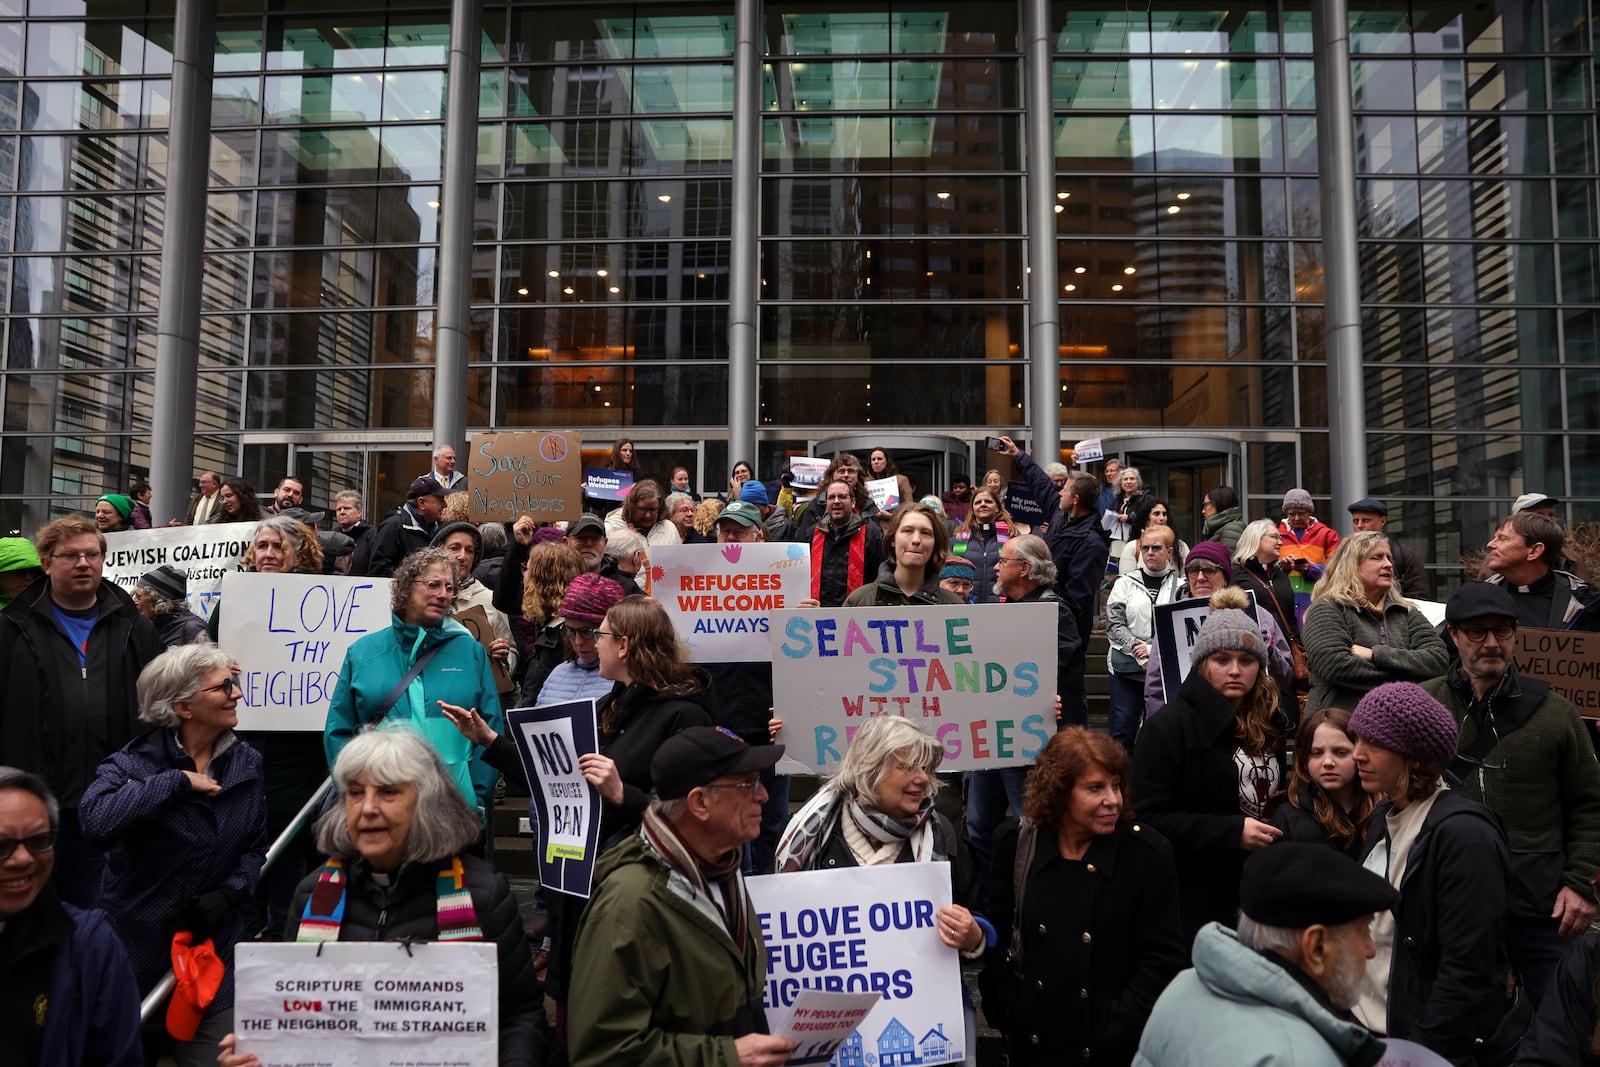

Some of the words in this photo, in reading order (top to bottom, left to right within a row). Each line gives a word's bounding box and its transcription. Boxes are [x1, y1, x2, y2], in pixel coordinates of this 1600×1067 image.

[473, 441, 539, 477] Save
[513, 471, 562, 489] Our
[588, 475, 620, 484] Refugees
[588, 481, 620, 490] Welcome
[473, 488, 566, 520] Neighbors
[105, 547, 167, 567] JEWISH
[173, 541, 251, 562] COALITION
[680, 574, 782, 591] REFUGEES
[268, 584, 373, 633] LOVE
[677, 594, 785, 611] WELCOME
[693, 618, 769, 634] ALWAYS
[781, 616, 973, 659] SEATTLE
[1184, 615, 1207, 647] N
[285, 640, 331, 664] THY
[1523, 634, 1585, 655] LOVE
[869, 657, 1039, 697] STANDS
[240, 671, 340, 707] NEIGHBO
[841, 695, 942, 718] WITH
[814, 714, 1049, 766] RGEES
[531, 731, 573, 777] NO
[548, 782, 583, 799] REFUGEE
[553, 804, 583, 837] BAN
[756, 913, 773, 941] E
[780, 905, 861, 940] LOVE
[868, 900, 935, 932] OUR
[767, 939, 868, 975] FUGEE
[275, 980, 363, 993] SCRIPTURE
[374, 980, 464, 993] COMMANDS
[283, 1000, 323, 1012] LOVE
[329, 1000, 358, 1012] THE
[374, 1000, 466, 1014] IMMIGRANT,
[793, 1008, 811, 1018] MY
[811, 1008, 843, 1020] PEOPLE
[843, 1008, 868, 1018] WERE
[241, 1019, 272, 1030] THE
[277, 1019, 362, 1033] NEIGHBOR,
[374, 1021, 398, 1031] THE
[402, 1020, 486, 1032] STRANGER
[792, 1021, 837, 1032] REFUGEES
